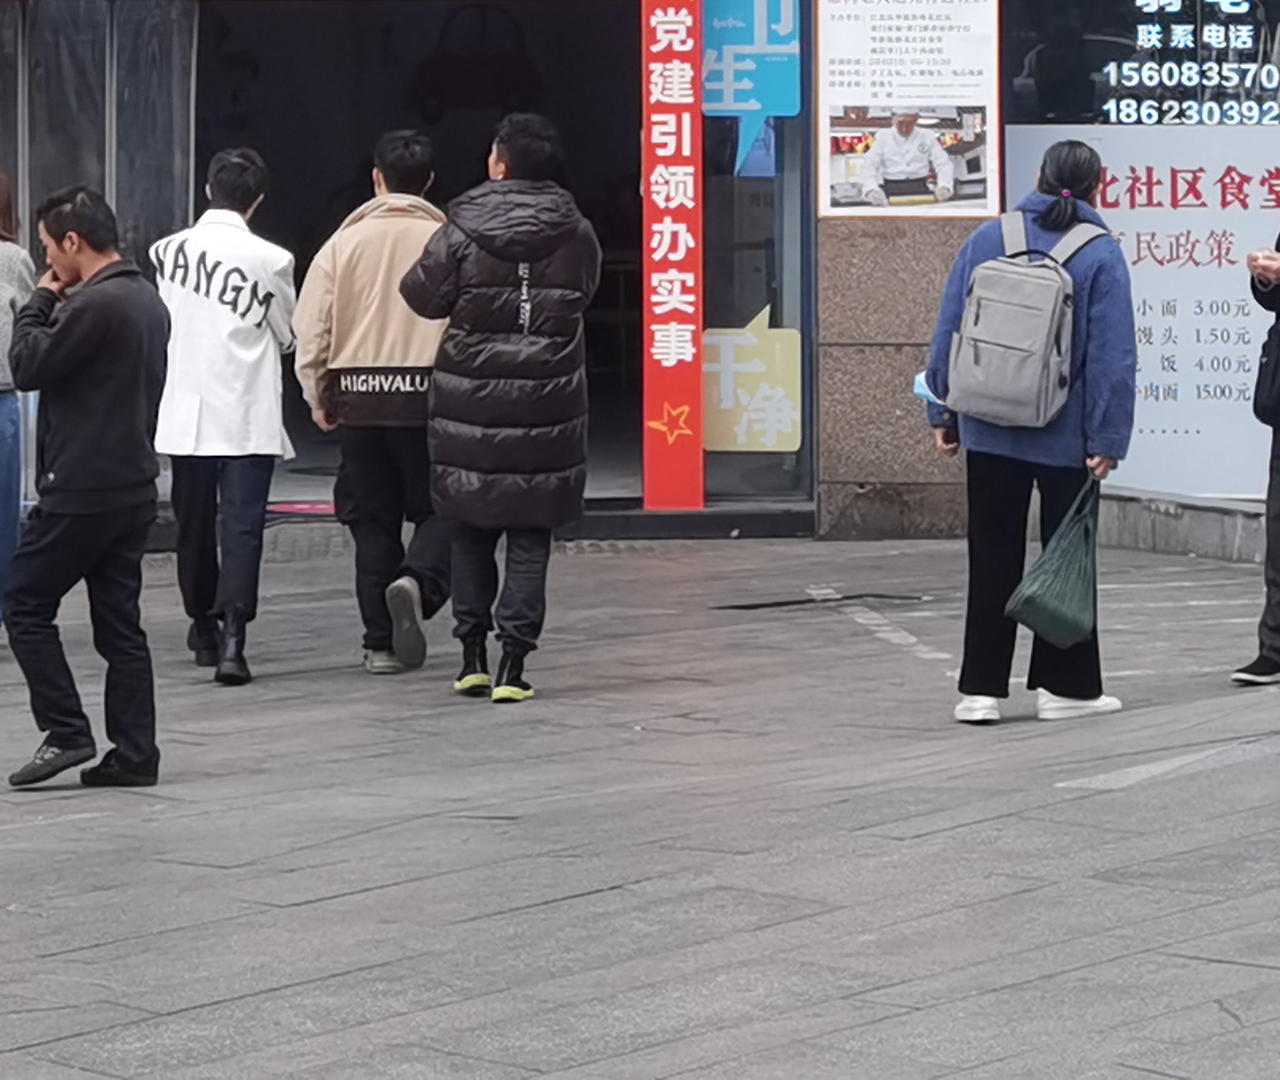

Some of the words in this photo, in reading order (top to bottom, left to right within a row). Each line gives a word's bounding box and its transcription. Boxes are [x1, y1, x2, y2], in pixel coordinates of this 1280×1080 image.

[1136, 24, 1254, 49] 联系电话
[648, 7, 697, 368] 党建引领办实事
[1115, 229, 1240, 268] 民政策
[1193, 298, 1251, 318] 3.00元
[1194, 326, 1251, 346] 1.50元
[1194, 354, 1251, 374] 4.00元
[340, 374, 429, 393] HIGHVALU
[1136, 382, 1178, 402] 肉面
[1195, 382, 1252, 402] 15.00元
